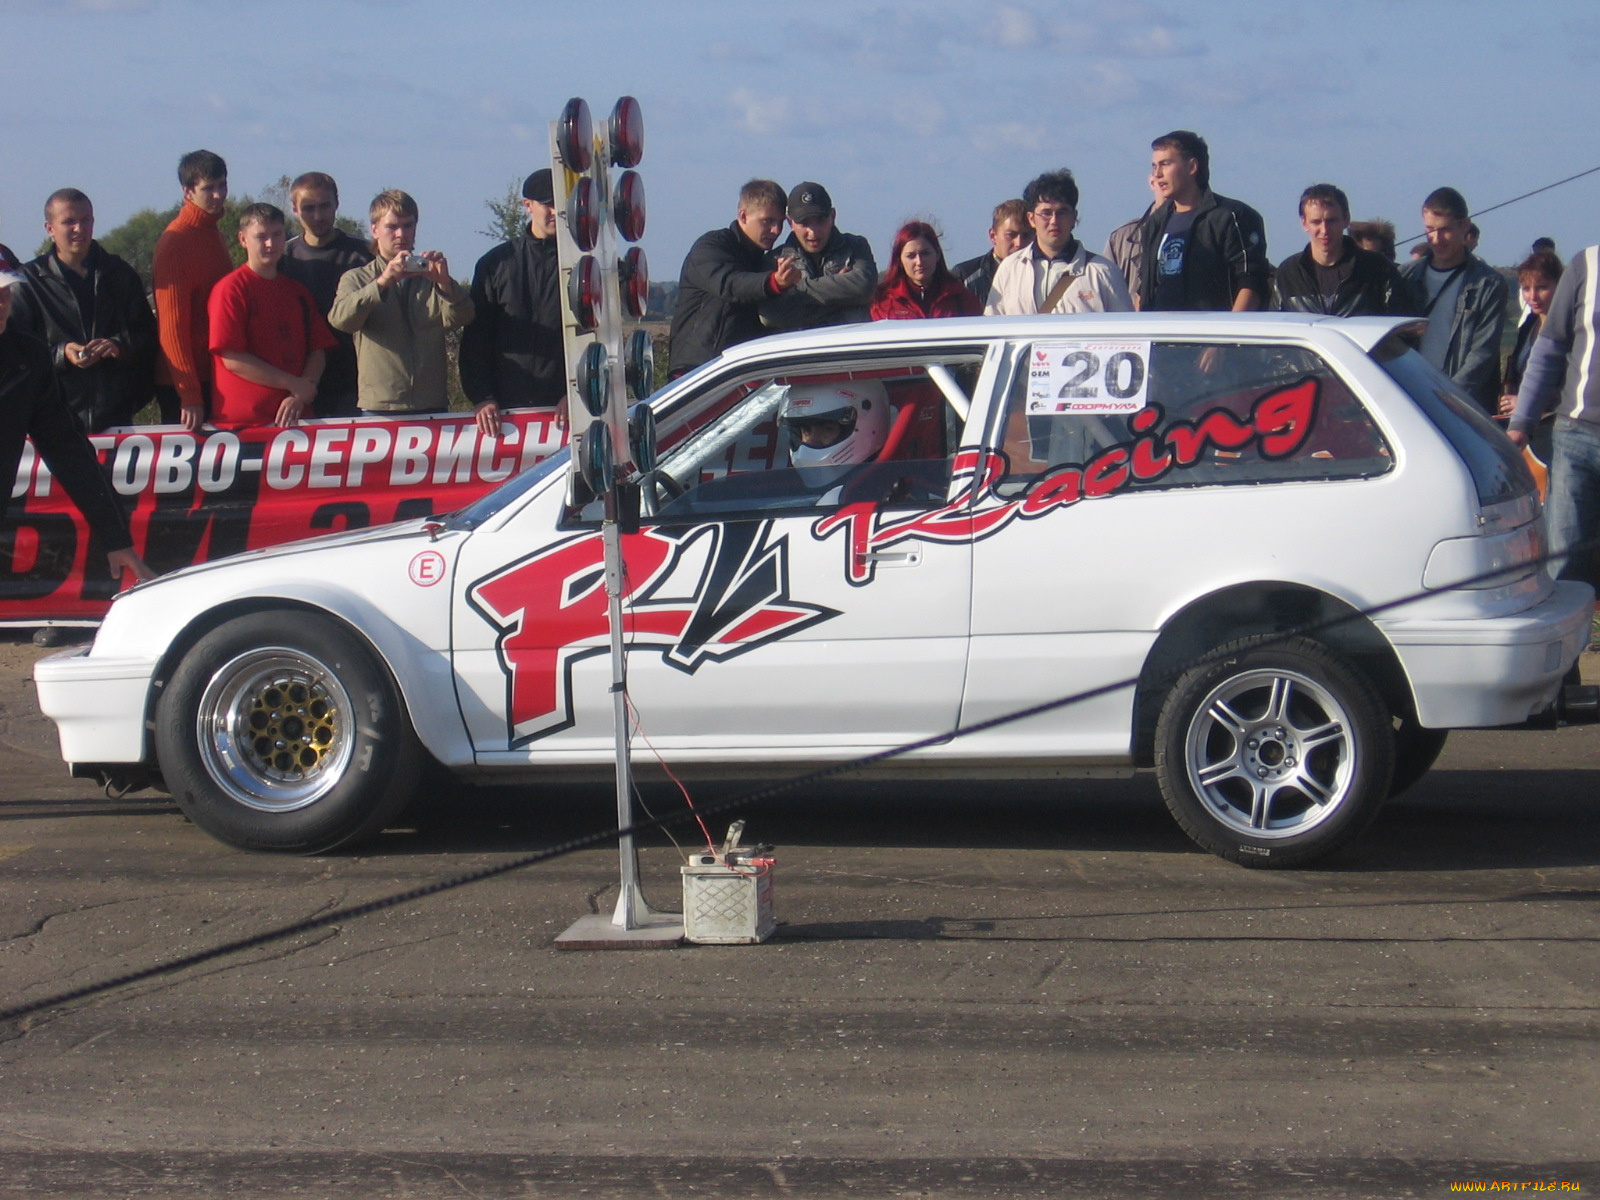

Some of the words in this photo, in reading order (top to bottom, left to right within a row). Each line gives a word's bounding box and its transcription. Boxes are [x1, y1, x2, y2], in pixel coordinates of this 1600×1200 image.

[1058, 351, 1145, 399] 20
[12, 421, 567, 498] ОВО-СЕРВИСН
[813, 377, 1320, 586] Racing
[420, 559, 434, 578] E
